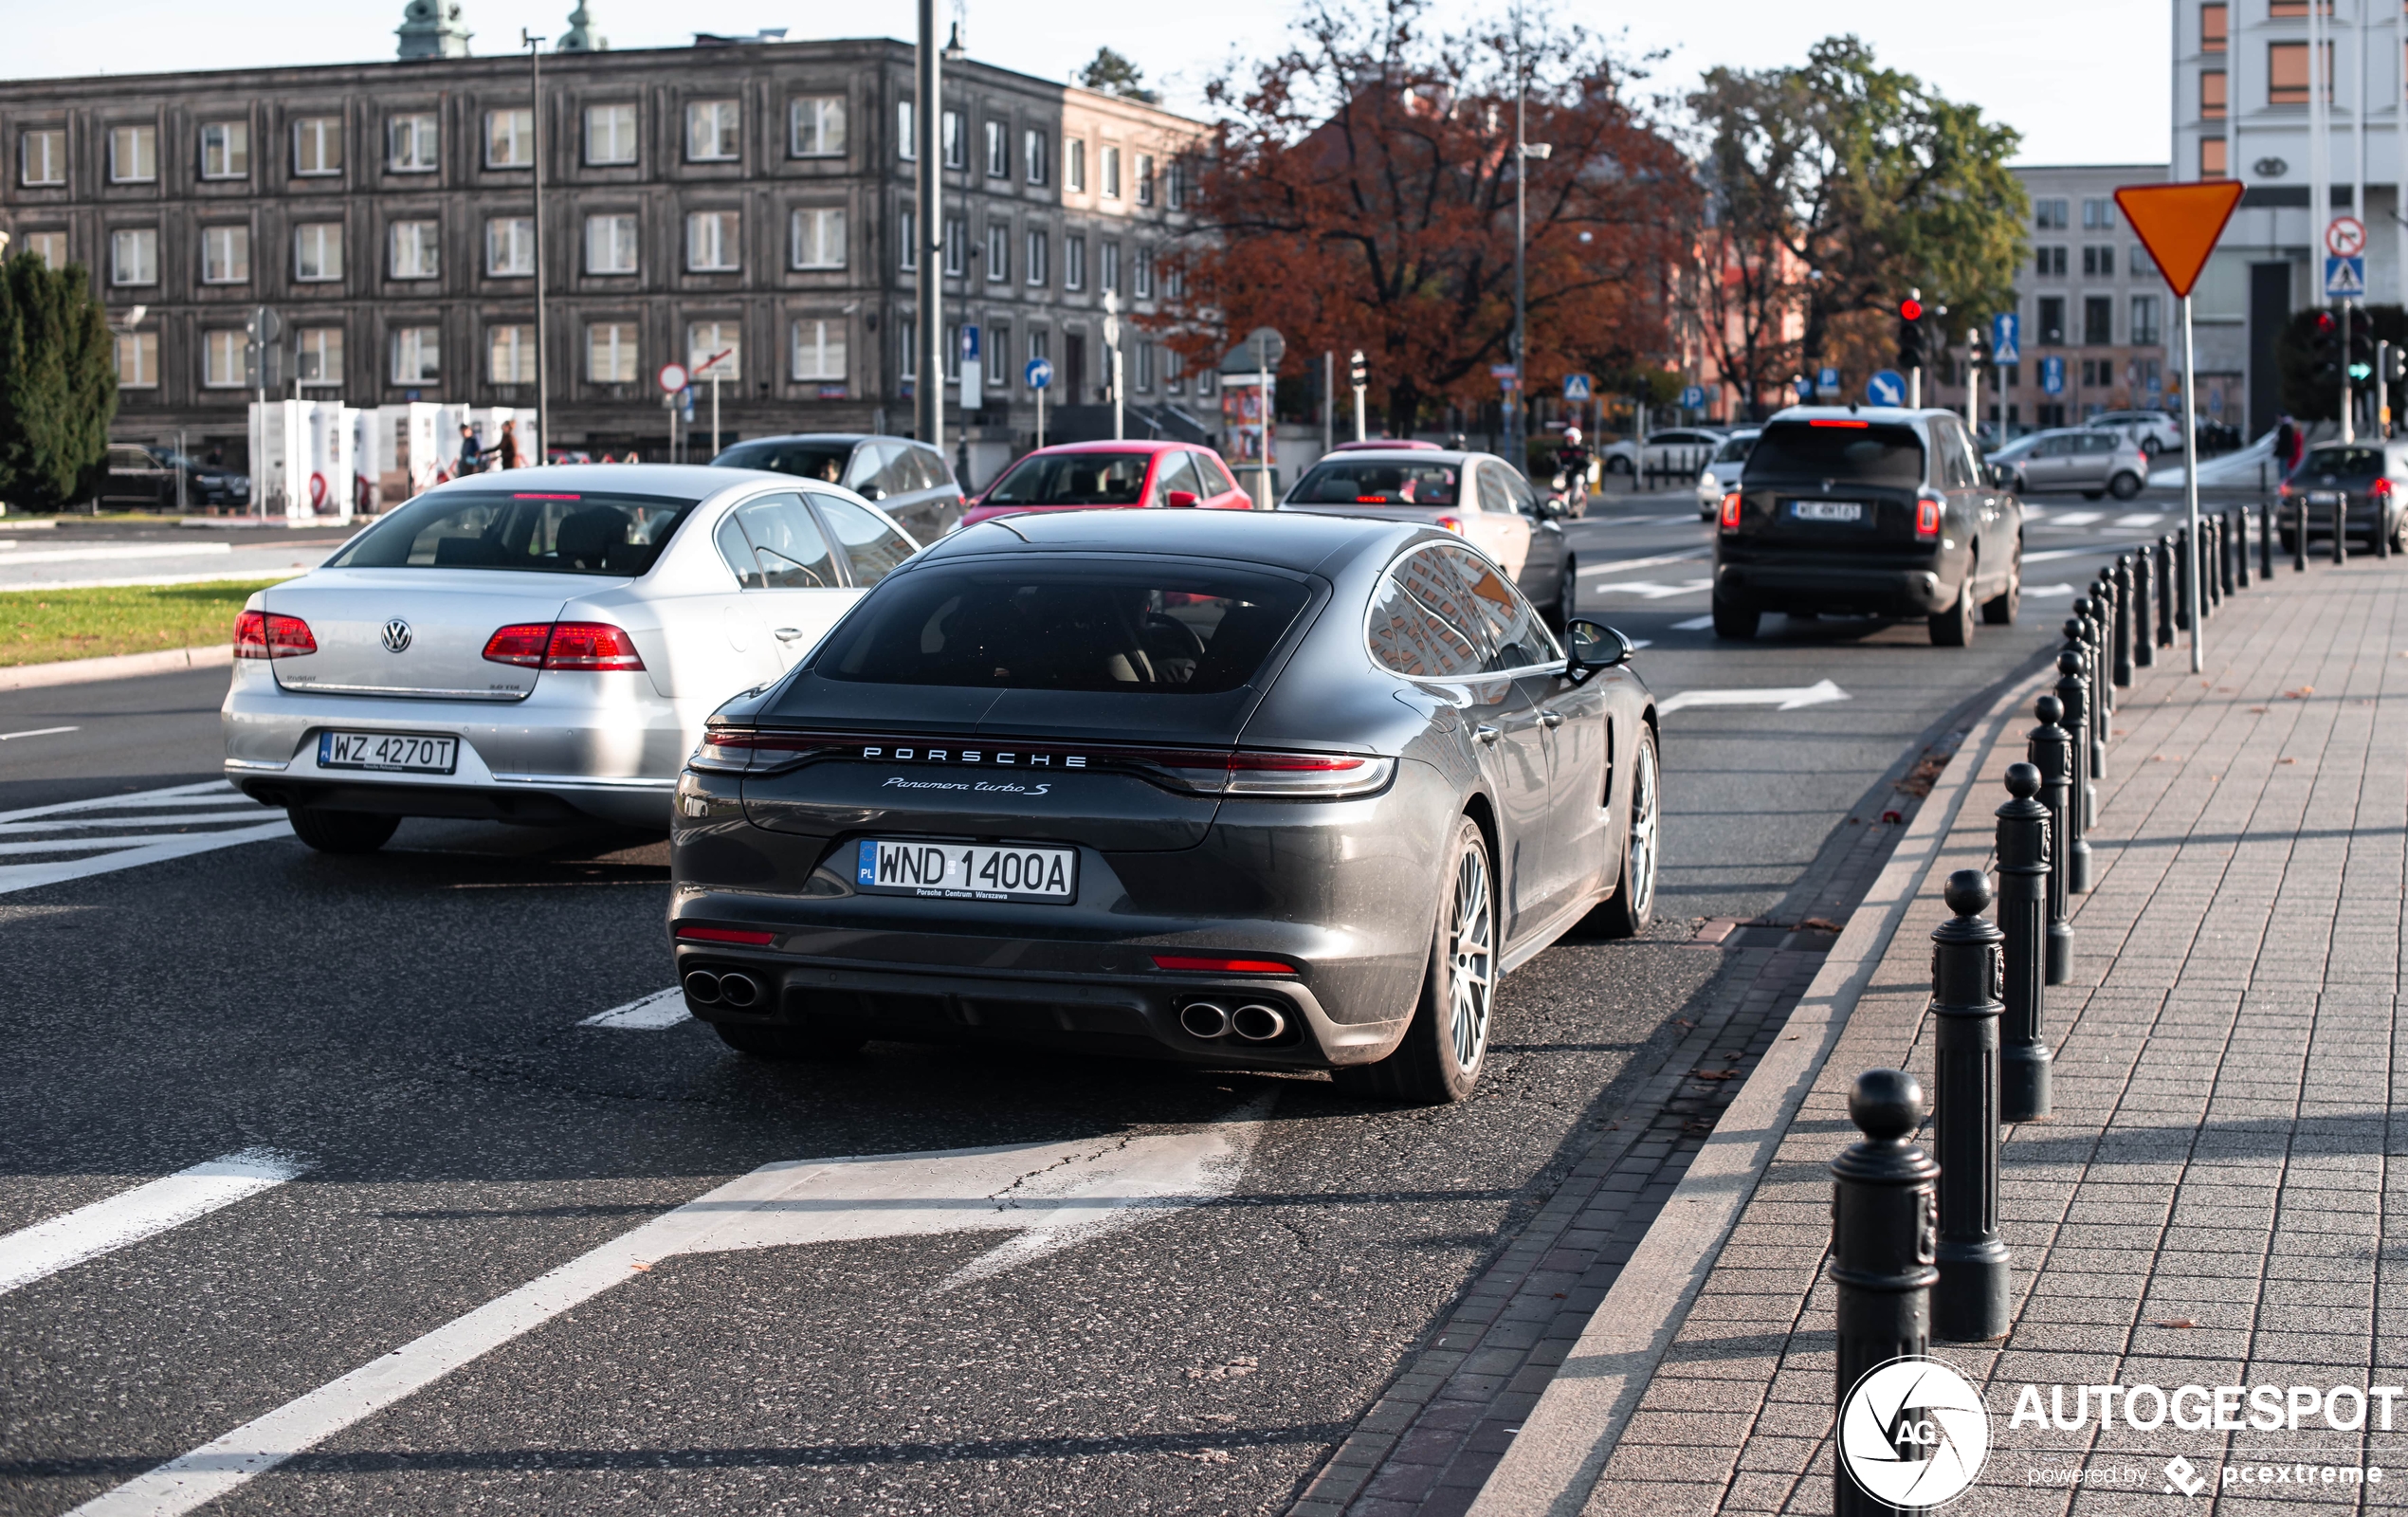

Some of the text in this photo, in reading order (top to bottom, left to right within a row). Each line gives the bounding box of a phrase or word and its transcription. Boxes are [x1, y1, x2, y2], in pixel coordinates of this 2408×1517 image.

[1687, 389, 1701, 406] P
[320, 750, 329, 758] PL
[335, 736, 450, 766] WZ 4270T
[864, 746, 1086, 767] PORSCHE
[882, 777, 1051, 795] Panamera turbo S
[861, 868, 873, 879] PL
[880, 846, 1067, 892] WND 1400A
[917, 887, 1008, 900] Porsche Centrum Warszawa
